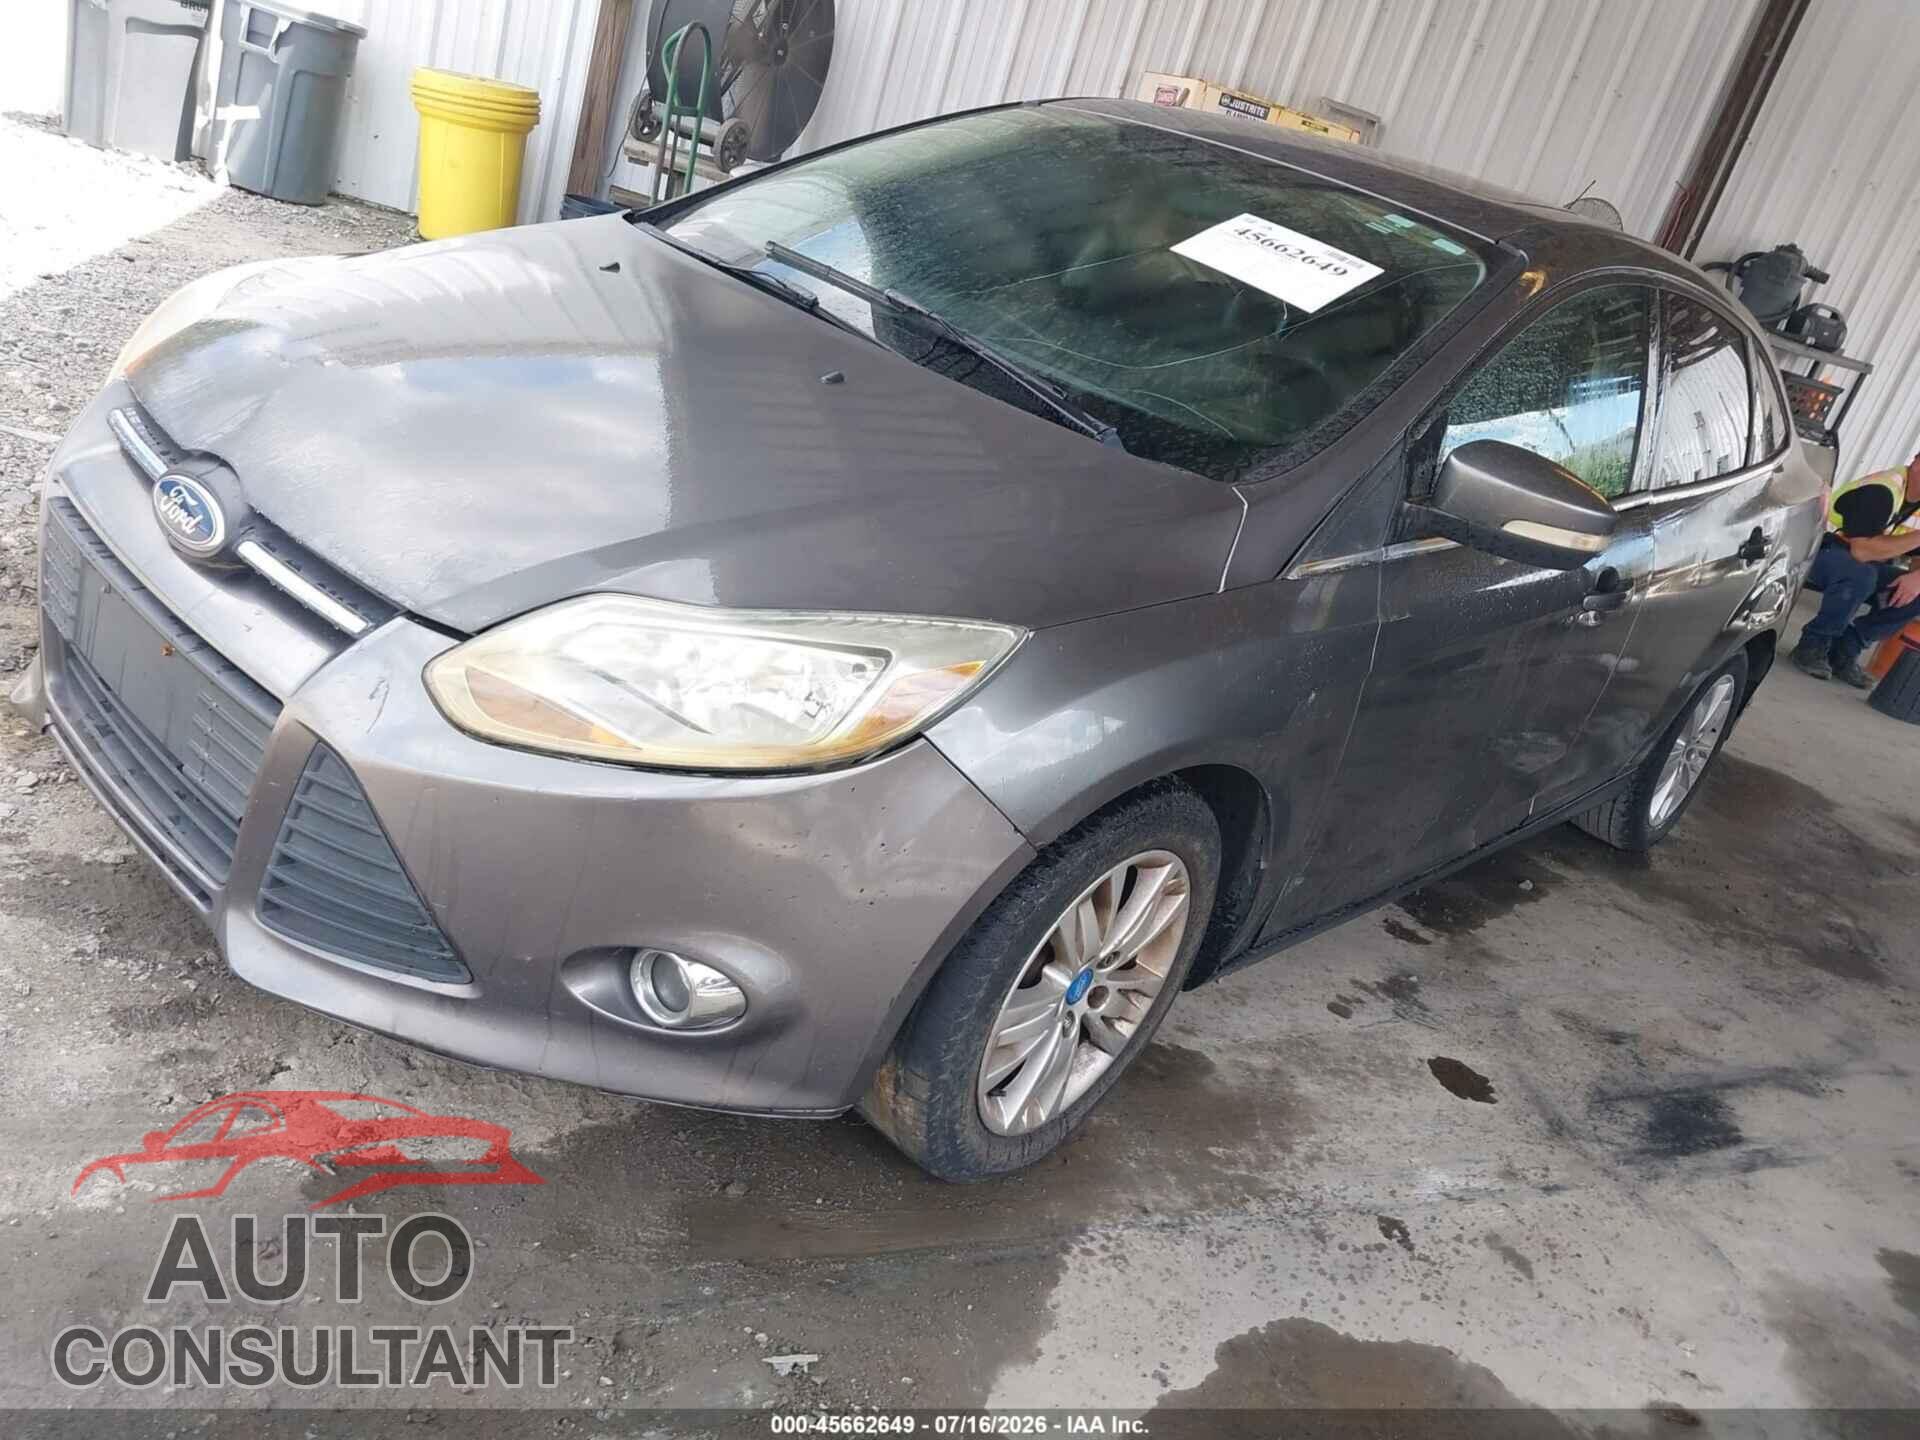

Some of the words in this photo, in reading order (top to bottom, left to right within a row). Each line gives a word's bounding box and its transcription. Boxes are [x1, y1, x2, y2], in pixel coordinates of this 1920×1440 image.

[1230, 98, 1265, 117] JUSTRITE
[1234, 228, 1348, 275] 45662649
[159, 486, 203, 534] Ford
